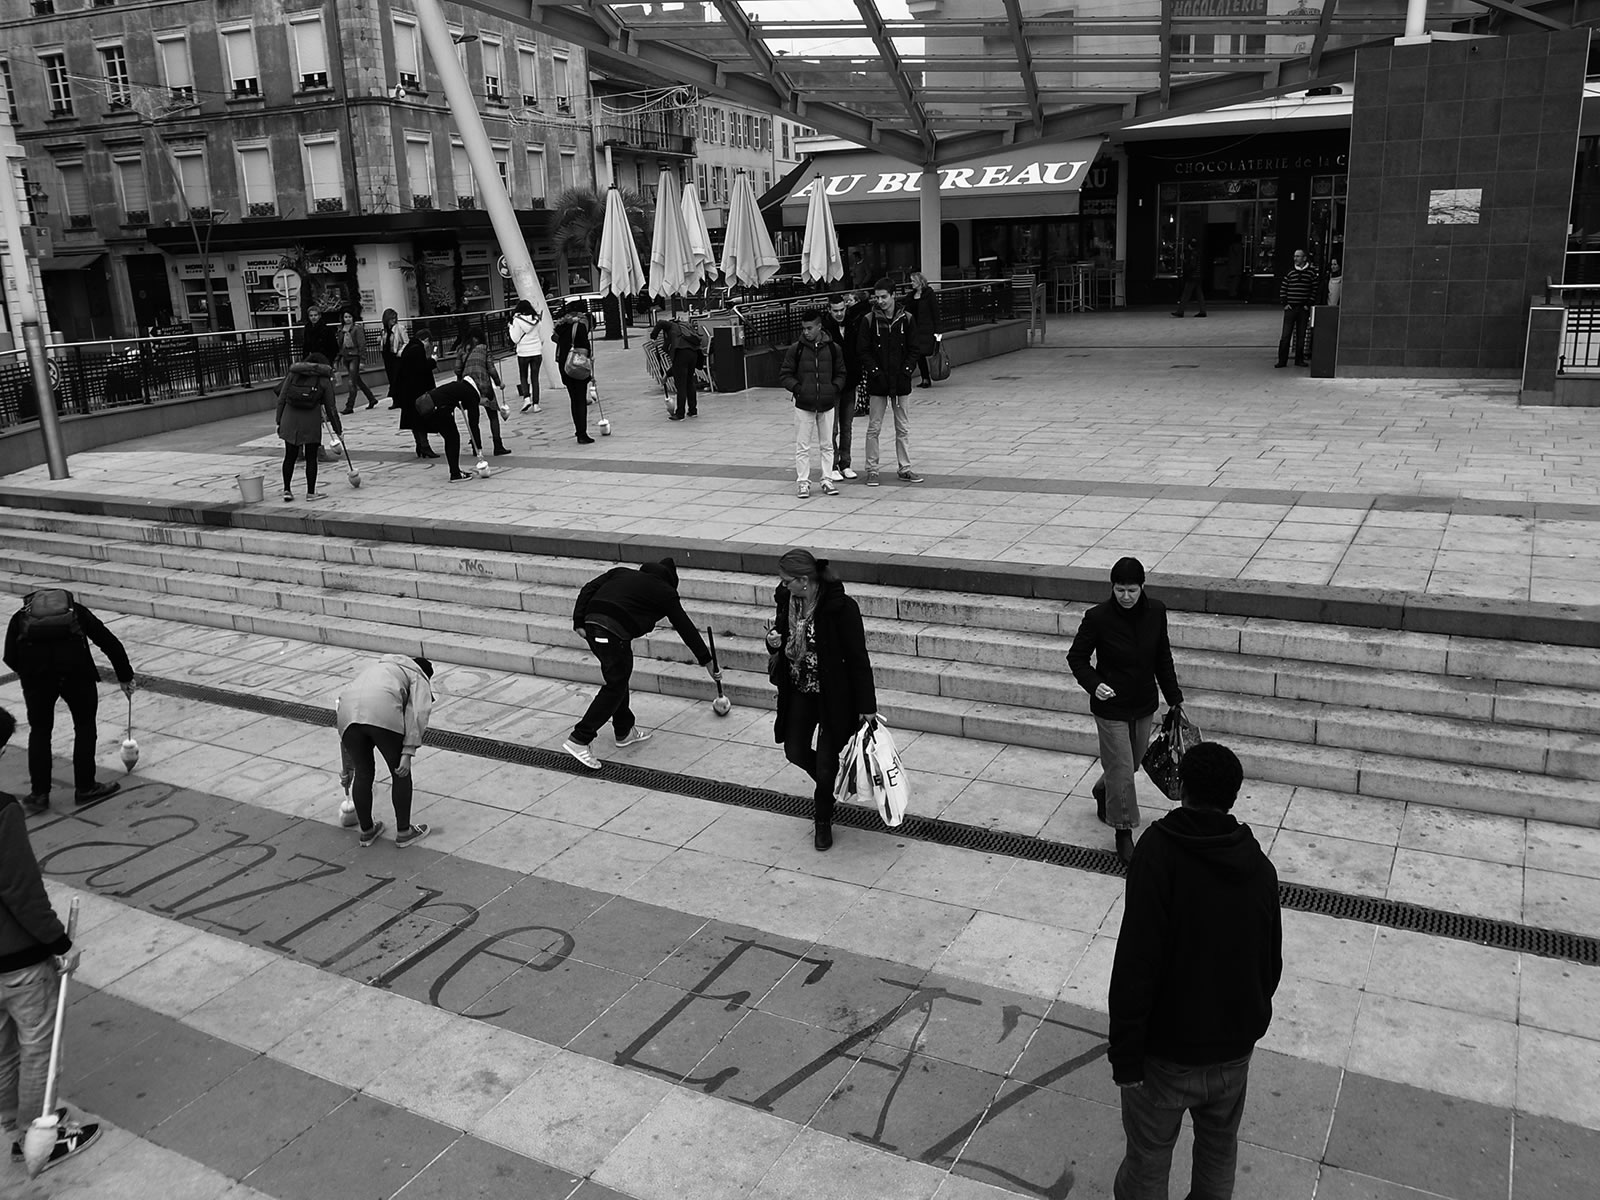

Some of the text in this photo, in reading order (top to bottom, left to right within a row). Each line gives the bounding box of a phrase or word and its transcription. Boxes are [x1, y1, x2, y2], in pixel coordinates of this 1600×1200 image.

[1175, 157, 1289, 174] CHOCOLATERIE
[1295, 155, 1312, 168] de
[791, 160, 1087, 198] AU BUREAU
